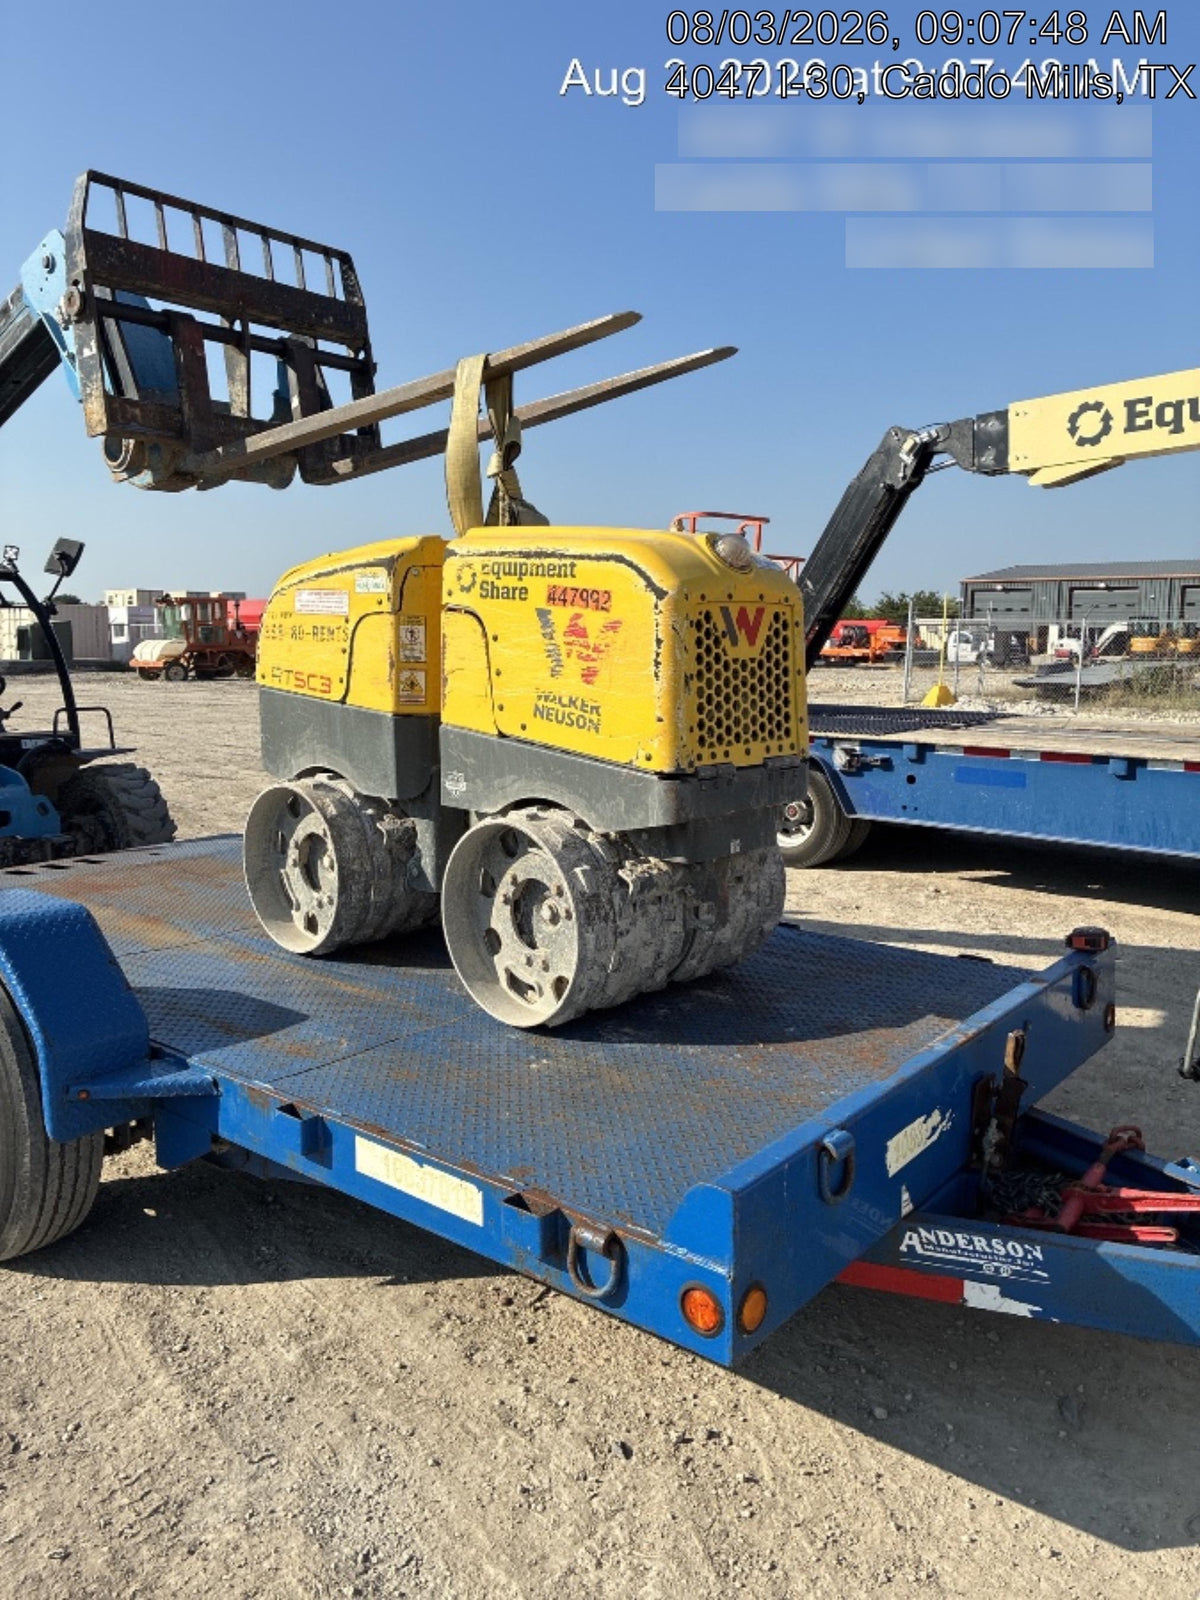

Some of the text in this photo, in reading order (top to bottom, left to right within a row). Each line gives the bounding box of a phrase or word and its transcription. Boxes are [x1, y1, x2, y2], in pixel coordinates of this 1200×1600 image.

[480, 560, 577, 582] Equipment
[479, 580, 529, 602] Share
[548, 585, 612, 613] 447992
[532, 704, 602, 735] NEUSON
[899, 1227, 1044, 1261] ANDERSON
